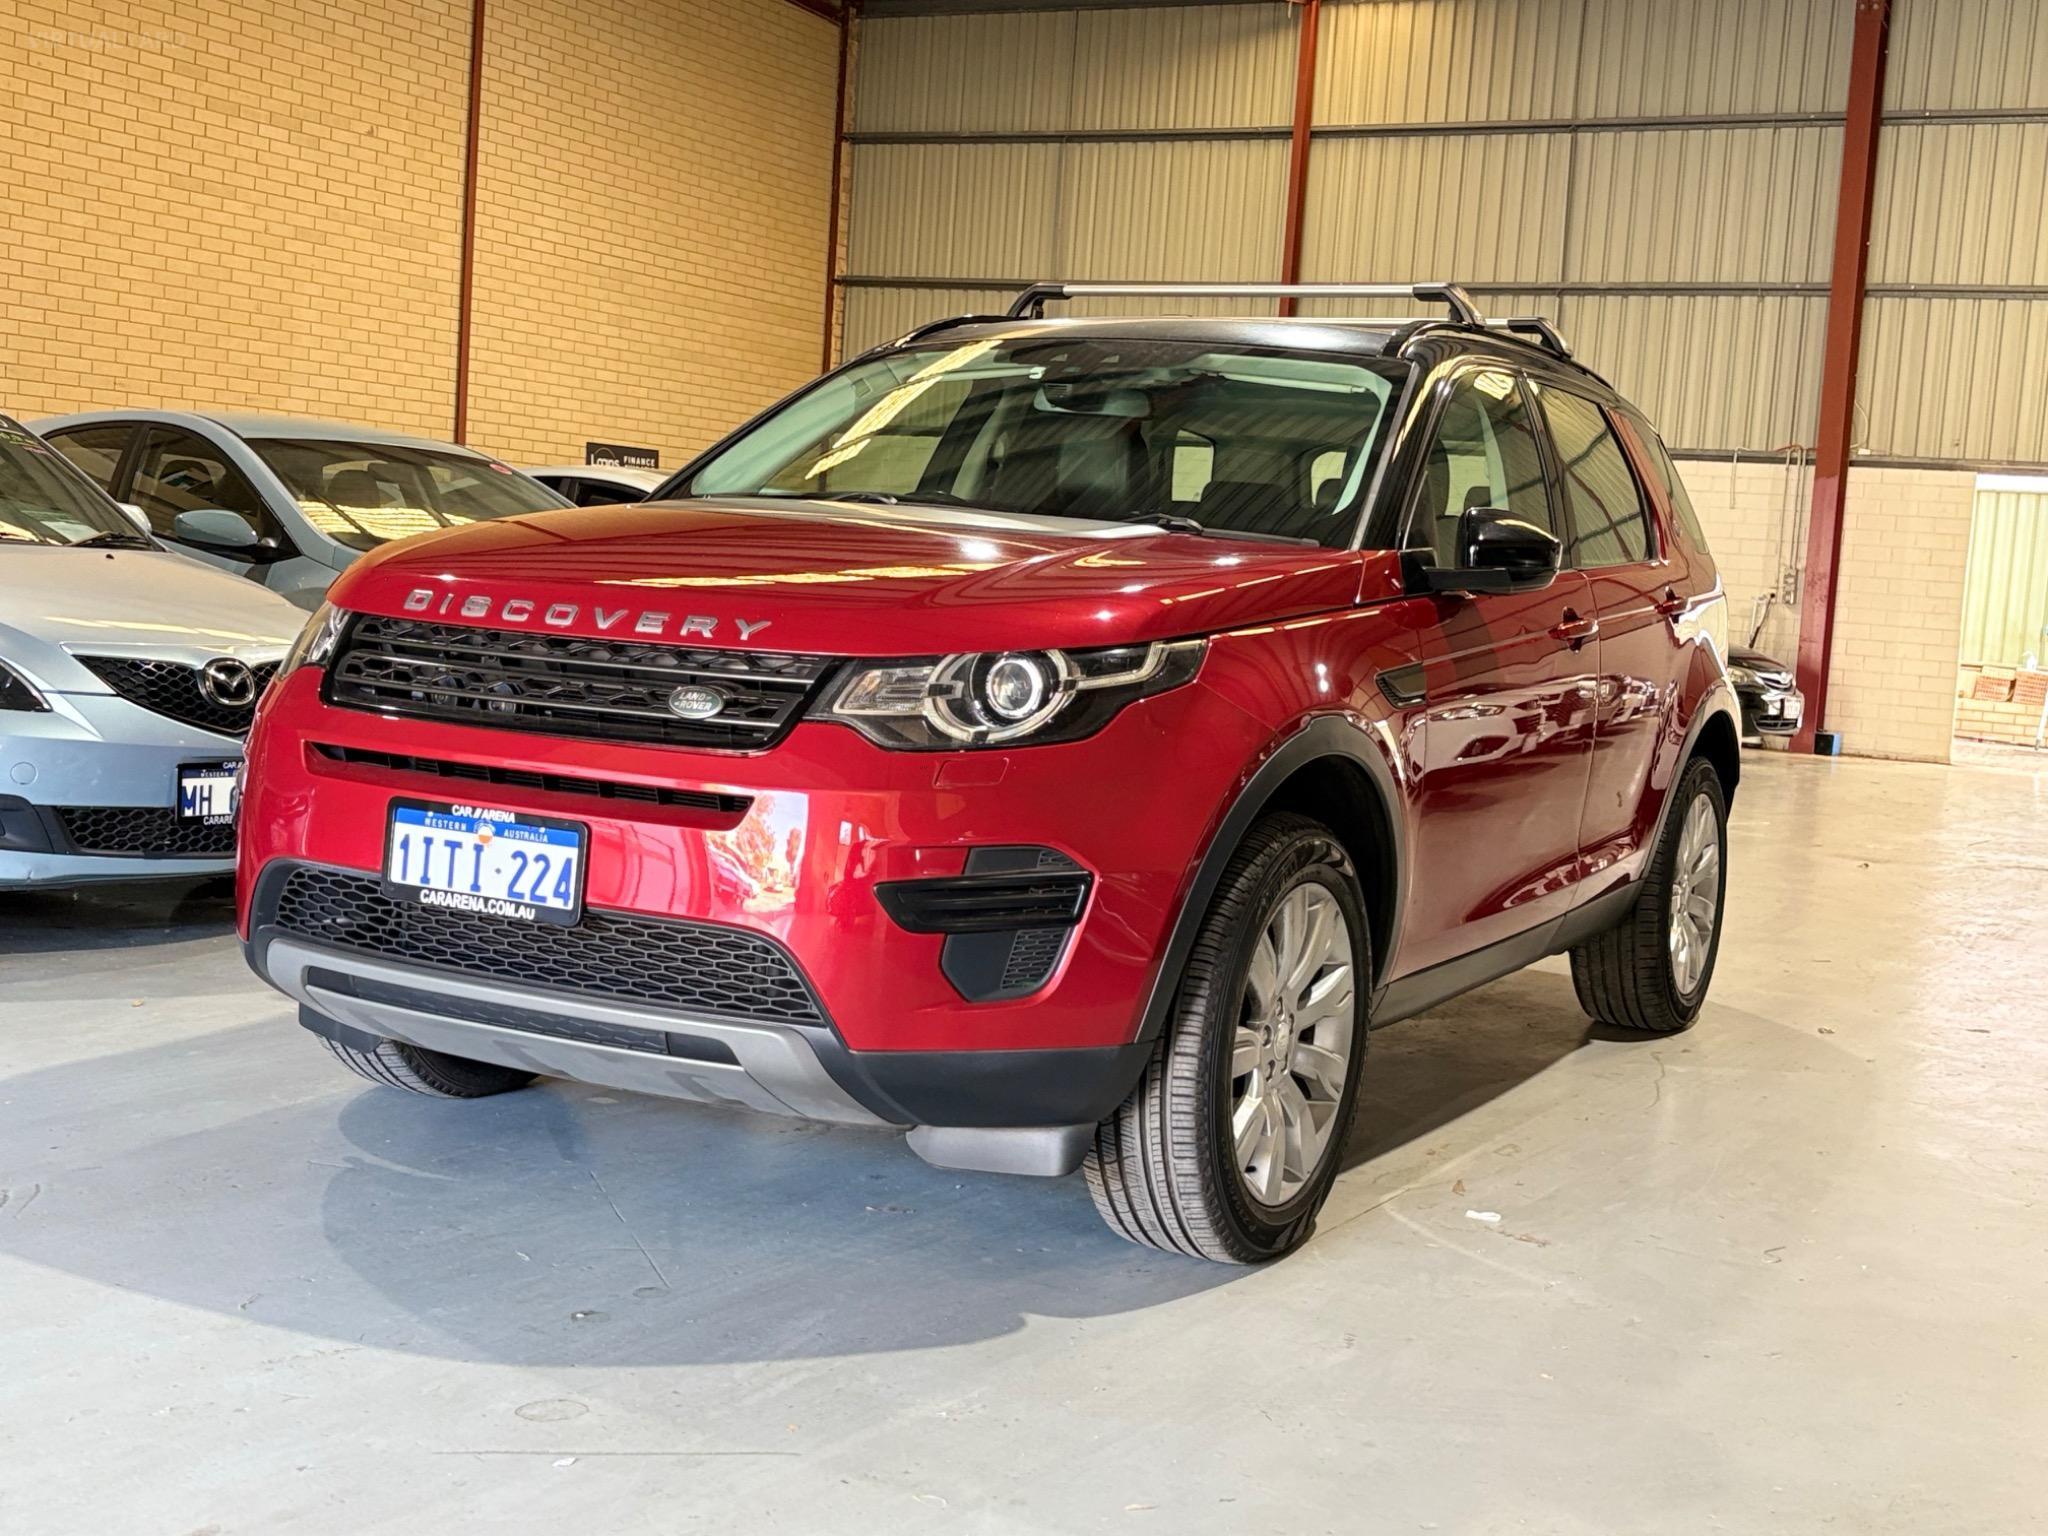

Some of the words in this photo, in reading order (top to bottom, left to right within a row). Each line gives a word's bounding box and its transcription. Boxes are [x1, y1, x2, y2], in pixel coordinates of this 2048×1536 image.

[623, 455, 656, 467] FINANCE
[403, 588, 772, 640] DISCOVERY
[679, 692, 706, 701] LAND
[679, 701, 713, 711] ROVER
[424, 817, 467, 832] WESTERN
[503, 828, 549, 844] AUSTRALIA
[419, 889, 536, 921] CARARENA.COM.AU
